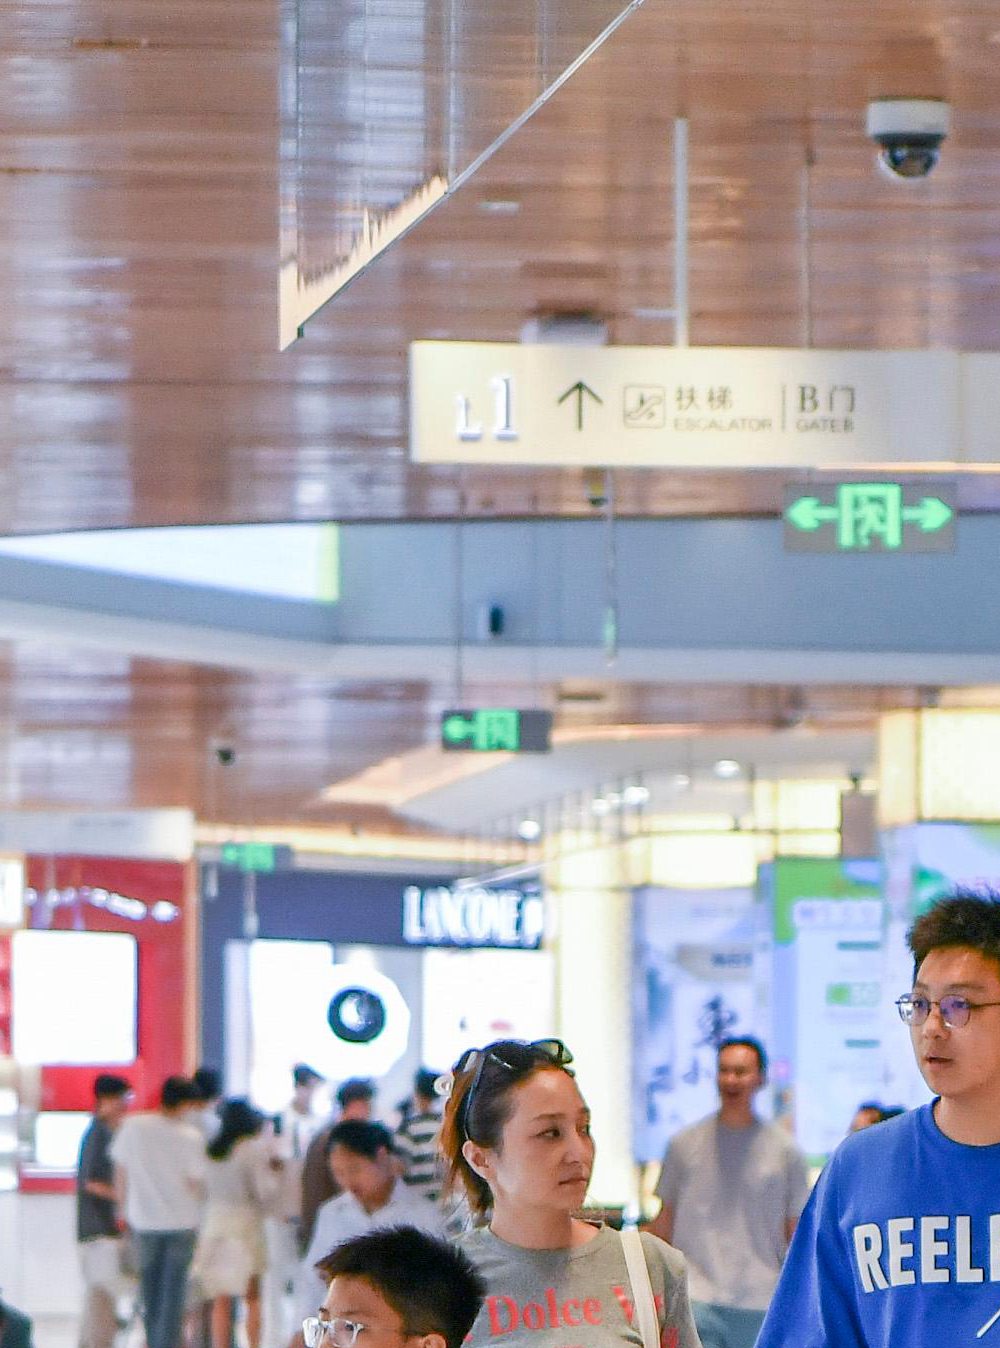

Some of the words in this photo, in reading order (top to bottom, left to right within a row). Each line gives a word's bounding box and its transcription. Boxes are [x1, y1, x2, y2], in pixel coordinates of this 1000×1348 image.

[676, 384, 732, 411] 扶梯
[674, 418, 772, 432] ESCALATOR
[484, 1286, 603, 1338] Dolce
